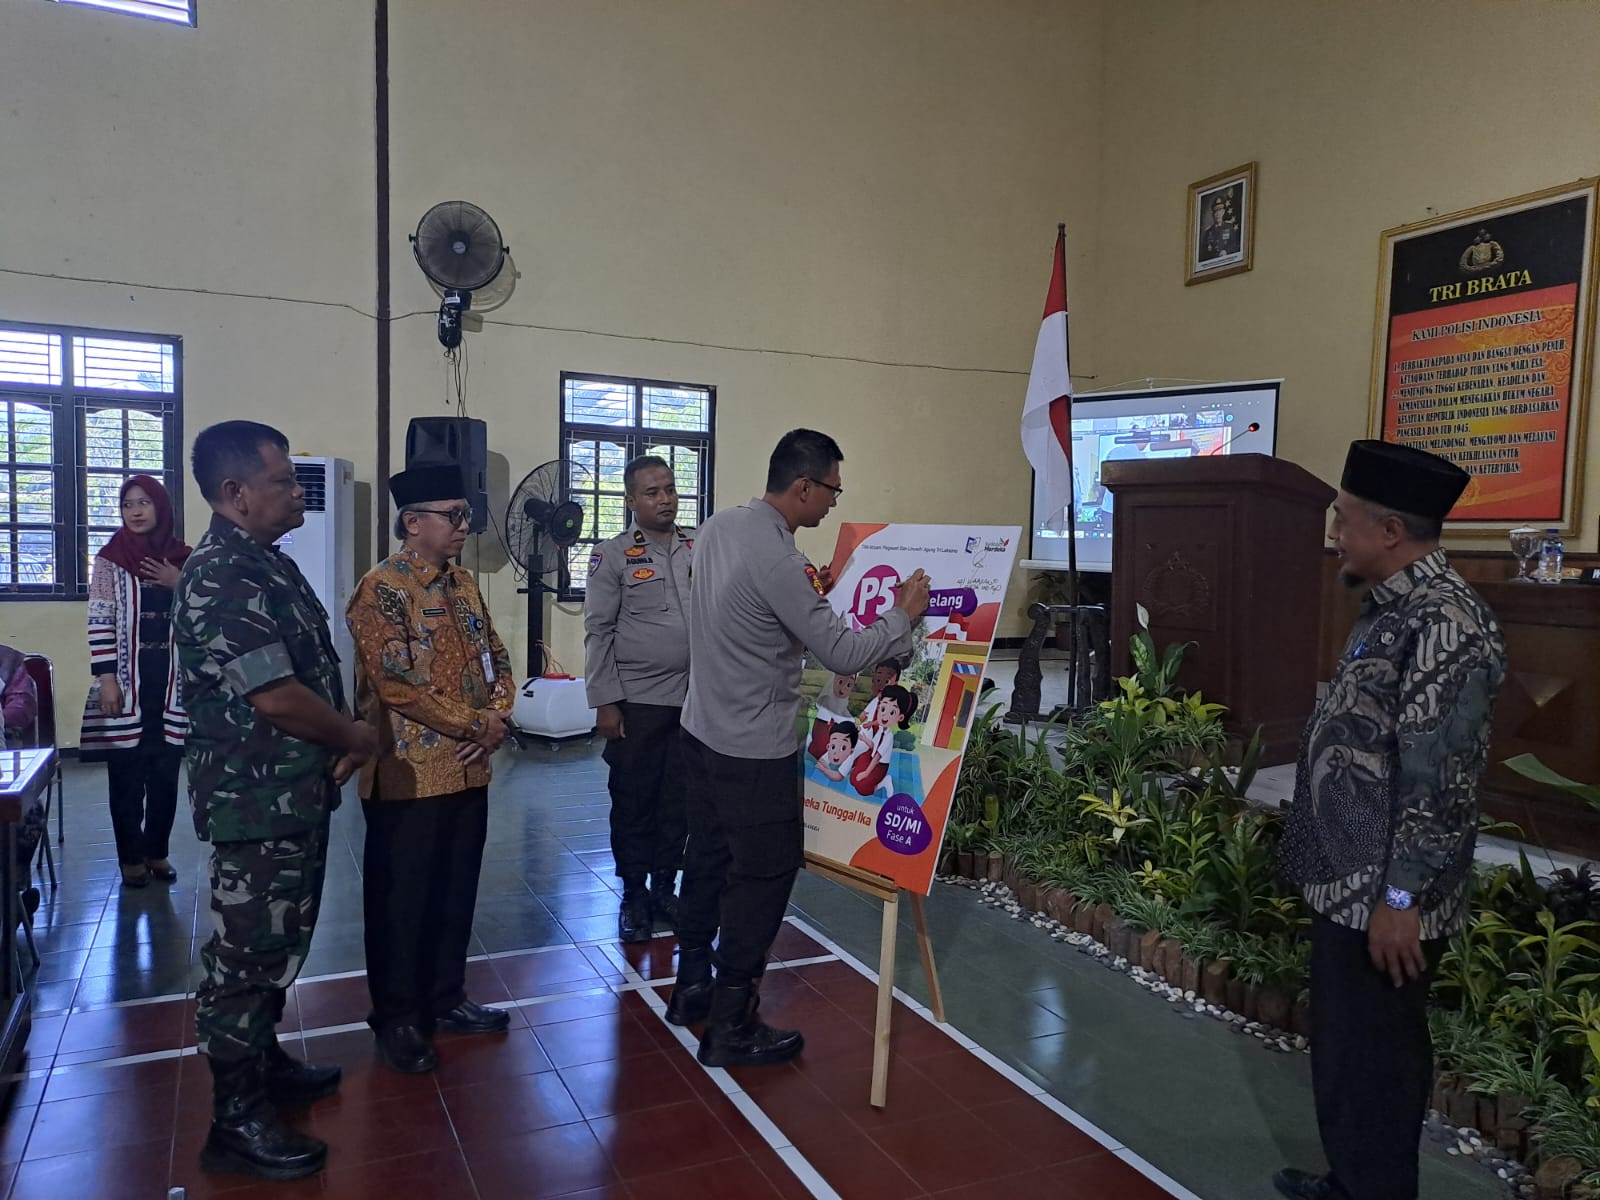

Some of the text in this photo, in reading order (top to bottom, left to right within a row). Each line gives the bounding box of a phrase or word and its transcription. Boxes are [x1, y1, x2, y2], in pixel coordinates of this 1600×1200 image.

[1430, 270, 1533, 302] TRI BRATA
[1412, 310, 1542, 341] KAMI POLISI INDONESIA
[1472, 351, 1485, 362] DAN
[1486, 346, 1511, 359] BANGSA
[1513, 343, 1540, 356] DENGAN
[1492, 361, 1508, 373] YANG
[1511, 359, 1529, 371] MAHA
[1531, 373, 1545, 384] DAN
[1438, 395, 1457, 407] DALAM
[1527, 386, 1554, 398] NEGARA
[1457, 407, 1489, 419] INDONESIA
[1491, 405, 1508, 416] YANG
[1510, 401, 1559, 414] BERDASARKAN
[1427, 425, 1439, 435] DAN
[1508, 433, 1521, 444] DAN
[1523, 431, 1556, 442] MELAYANI
[857, 576, 897, 615] P5
[929, 594, 963, 609] elang
[823, 801, 857, 822] Tunggal
[858, 812, 872, 827] Ika
[897, 805, 914, 814] untuk
[884, 812, 922, 834] SD/MI
[887, 830, 911, 846] Fase A
